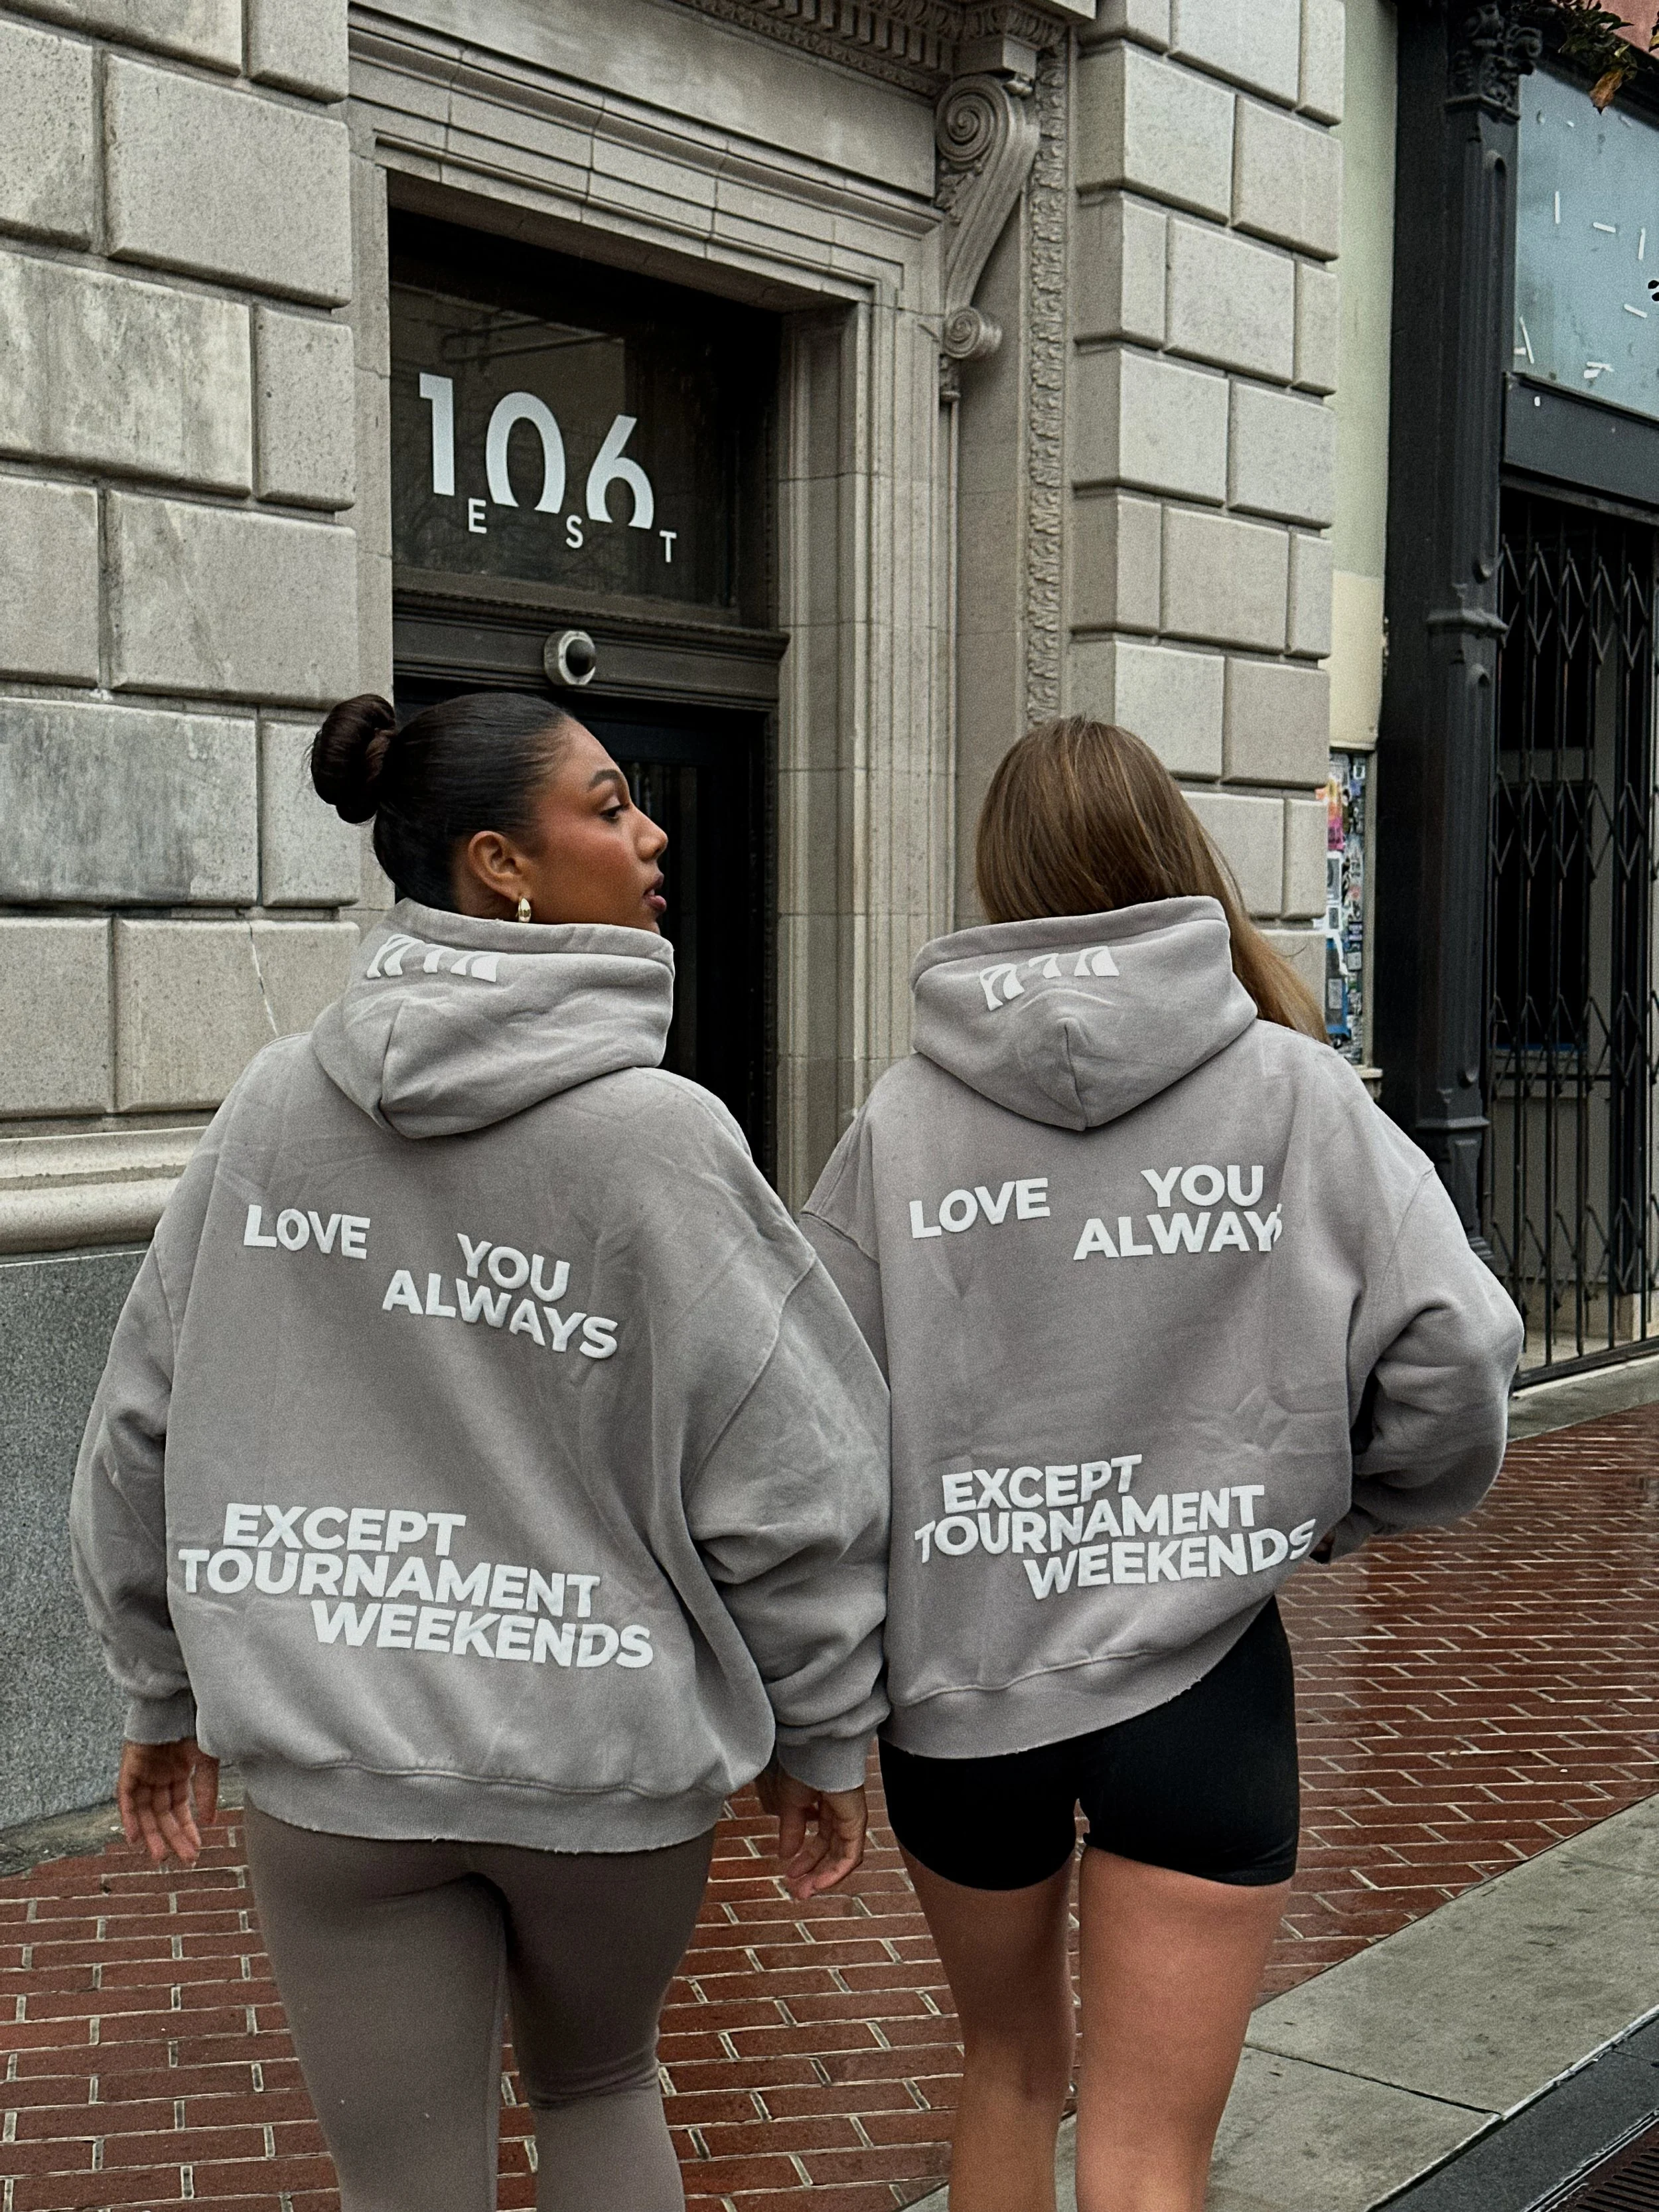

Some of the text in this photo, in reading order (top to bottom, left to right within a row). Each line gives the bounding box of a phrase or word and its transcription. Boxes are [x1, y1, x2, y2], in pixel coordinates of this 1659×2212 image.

[419, 372, 654, 530] 106
[909, 1164, 1263, 1239] LOVE YOU
[244, 1204, 571, 1302] LOVE YOU
[382, 1269, 618, 1359] ALWAYS
[942, 1453, 1142, 1513] EXCEPT
[222, 1503, 467, 1556] EXCEPT
[914, 1484, 1265, 1564] TOURNAMENT
[1023, 1518, 1316, 1600] WEEKENDS
[178, 1548, 601, 1618] TOURNAMENT
[310, 1599, 654, 1668] WEEKENDS
